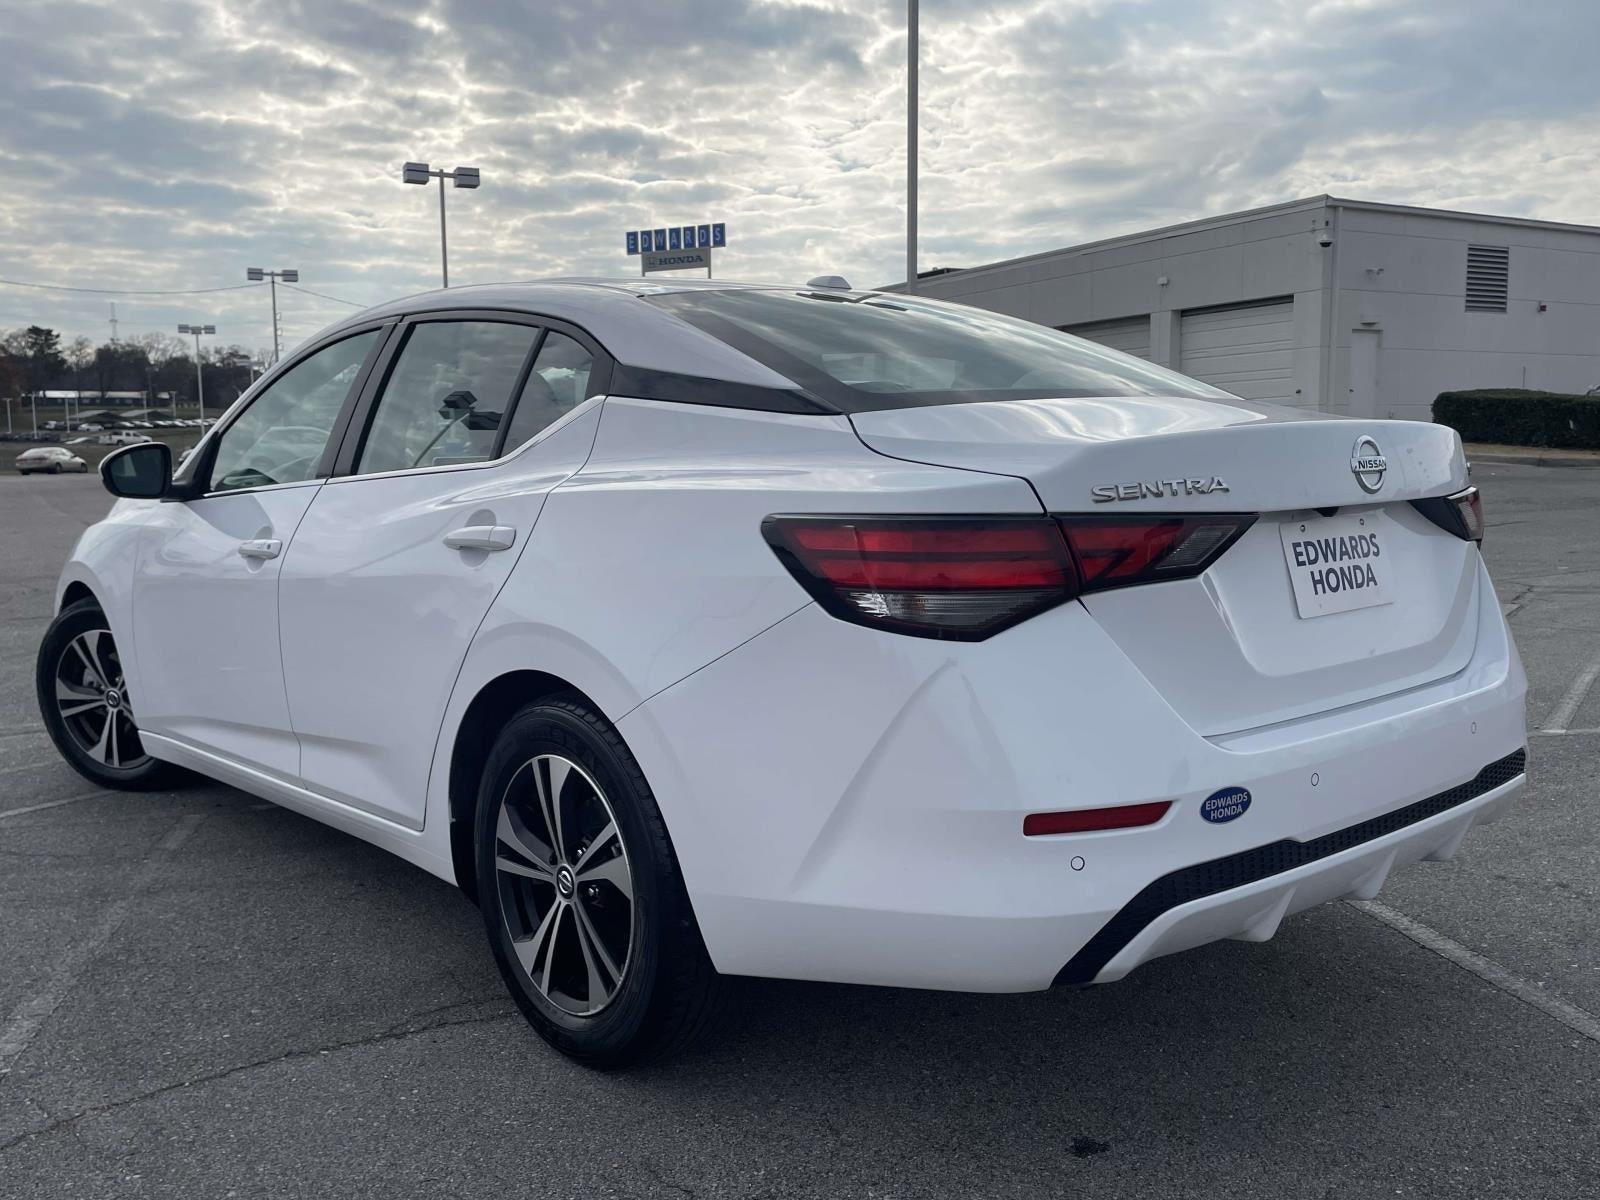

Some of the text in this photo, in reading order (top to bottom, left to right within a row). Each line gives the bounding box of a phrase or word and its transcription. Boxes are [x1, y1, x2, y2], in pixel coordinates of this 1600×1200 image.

[628, 226, 721, 250] EDWARDS
[658, 255, 704, 265] HONDA
[1091, 476, 1230, 503] SENTRA
[1292, 533, 1380, 567] EDWARDS
[1310, 562, 1378, 595] HONDA
[1205, 791, 1248, 811] EDWARDS
[1210, 804, 1243, 821] HONDA
